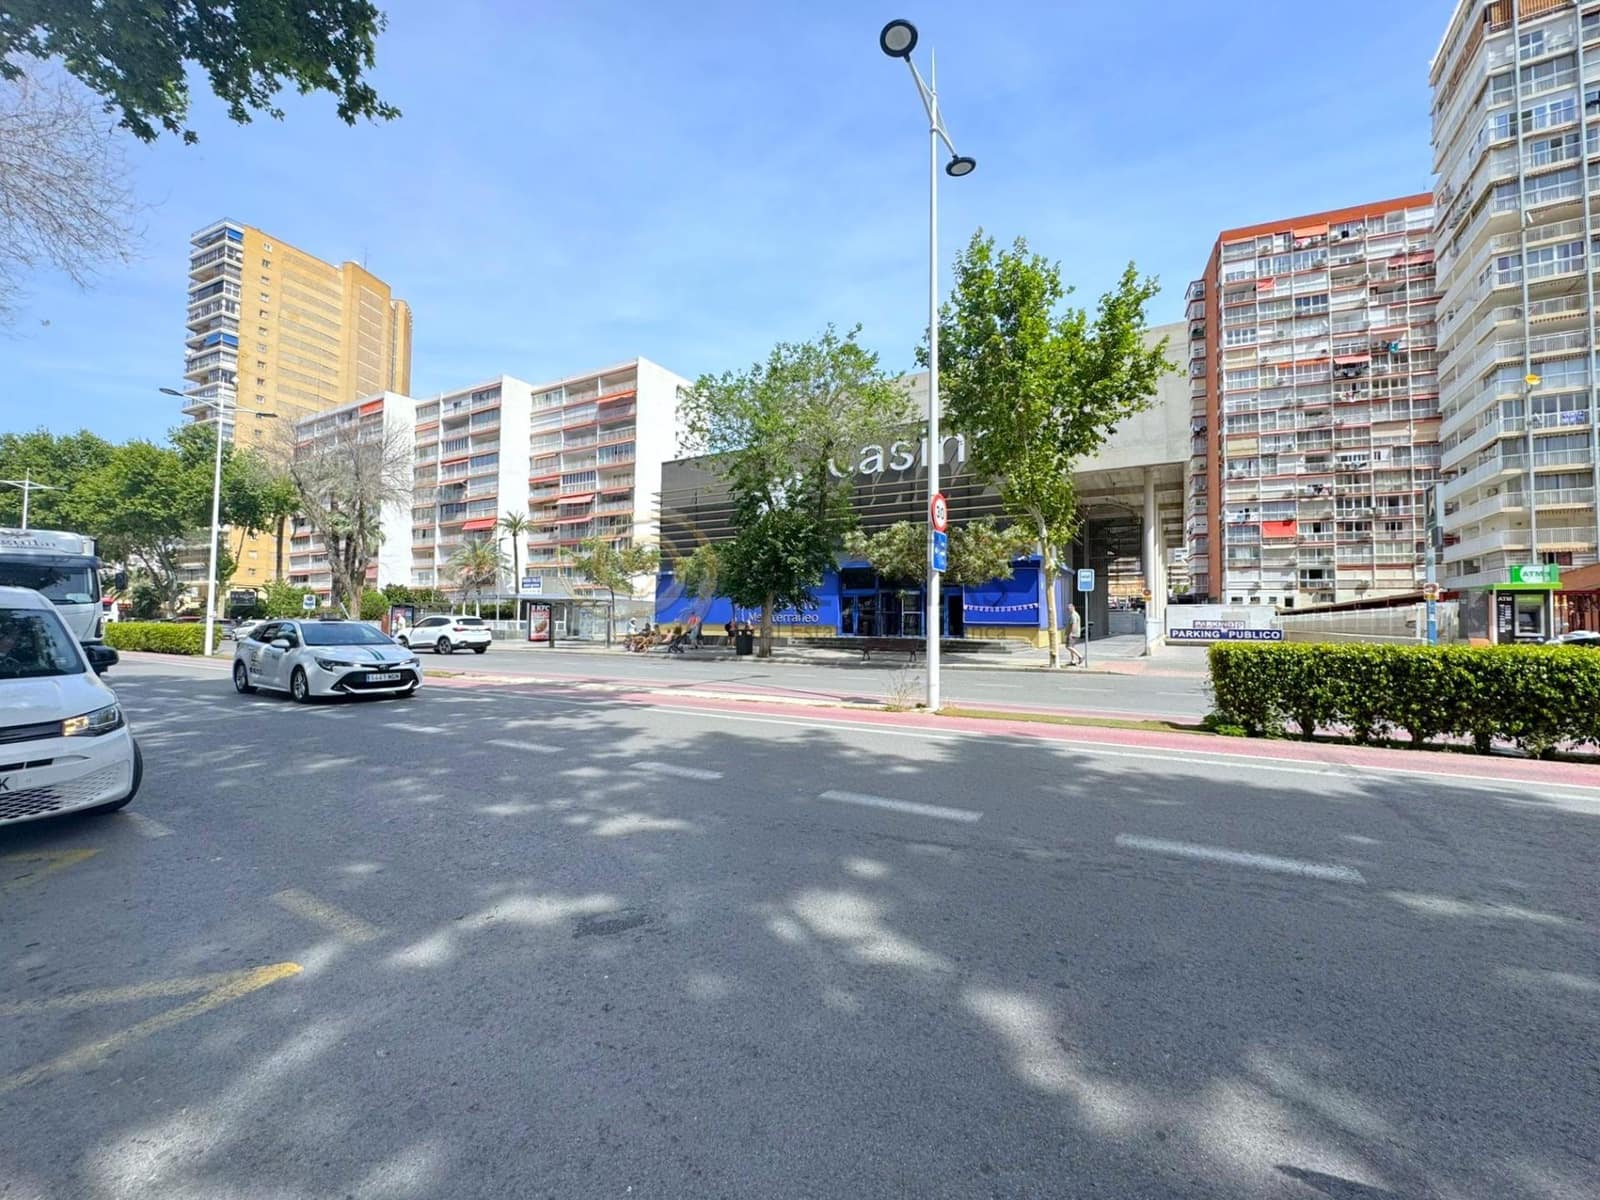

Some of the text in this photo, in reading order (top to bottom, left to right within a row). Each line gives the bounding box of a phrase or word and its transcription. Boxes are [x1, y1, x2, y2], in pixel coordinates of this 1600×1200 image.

[936, 505, 945, 520] 30
[1172, 630, 1281, 640] PARKING PUBLICO
